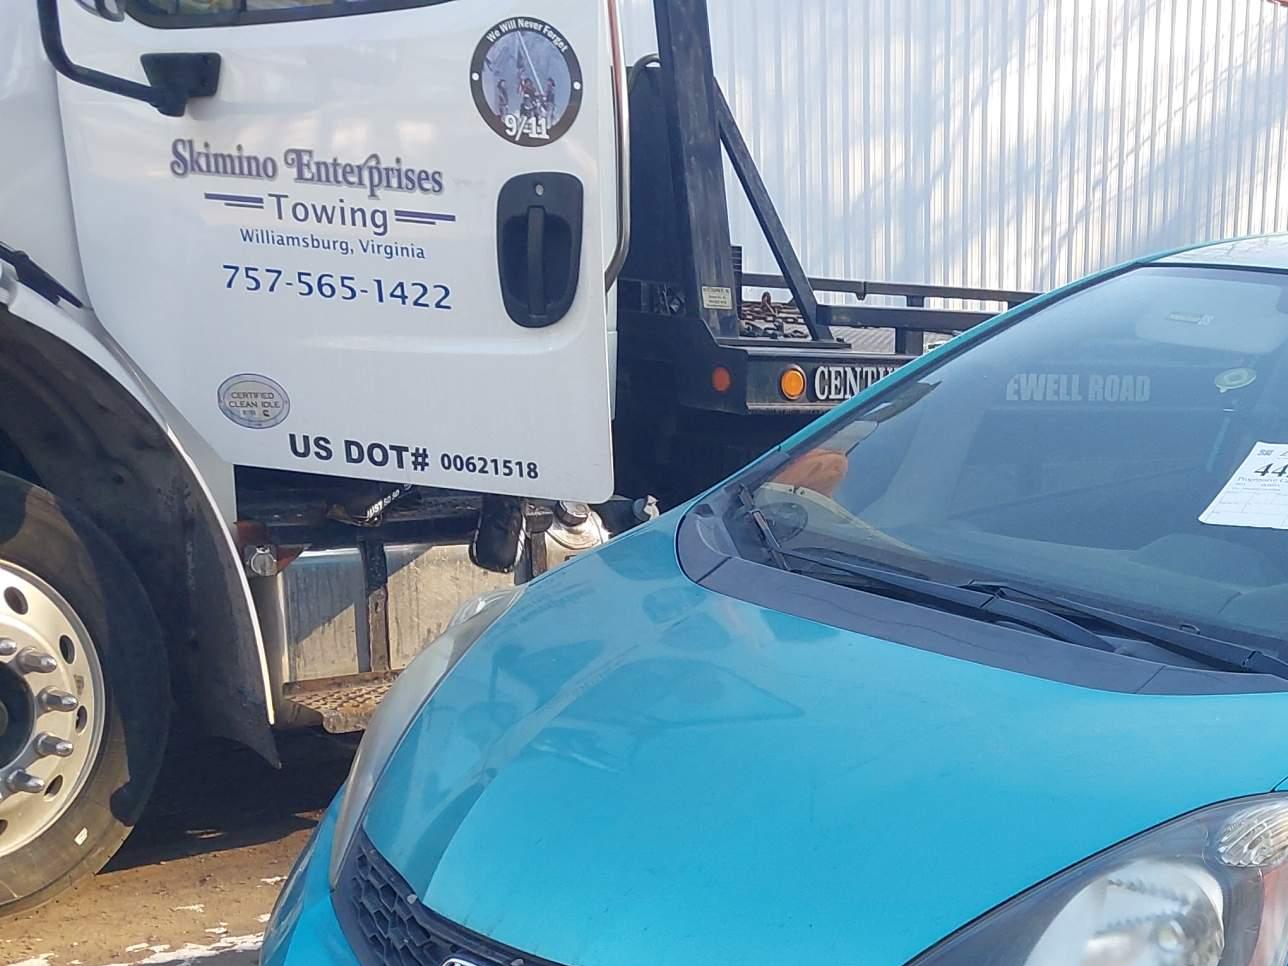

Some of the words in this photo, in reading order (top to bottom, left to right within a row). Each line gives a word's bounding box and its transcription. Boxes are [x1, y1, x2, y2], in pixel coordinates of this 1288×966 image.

[486, 30, 500, 42] We
[499, 19, 517, 33] Will
[517, 18, 543, 31] Never
[542, 25, 569, 53] Forget
[504, 114, 550, 141] 9/11
[170, 138, 277, 179] Skimino
[283, 148, 444, 200] Enterprises
[267, 193, 388, 237] Towing
[239, 227, 355, 256] Williamsburg,
[359, 238, 426, 260] Virginia
[222, 264, 452, 310] 757-565-1422
[231, 391, 275, 400] CERTIFIED
[814, 365, 900, 400] CENT
[1087, 374, 1151, 402] ROAD
[228, 400, 258, 408] CLEAN
[261, 400, 281, 409] IDLE
[288, 433, 333, 461] US
[344, 439, 429, 472] DOT#
[440, 453, 540, 479] 00621518
